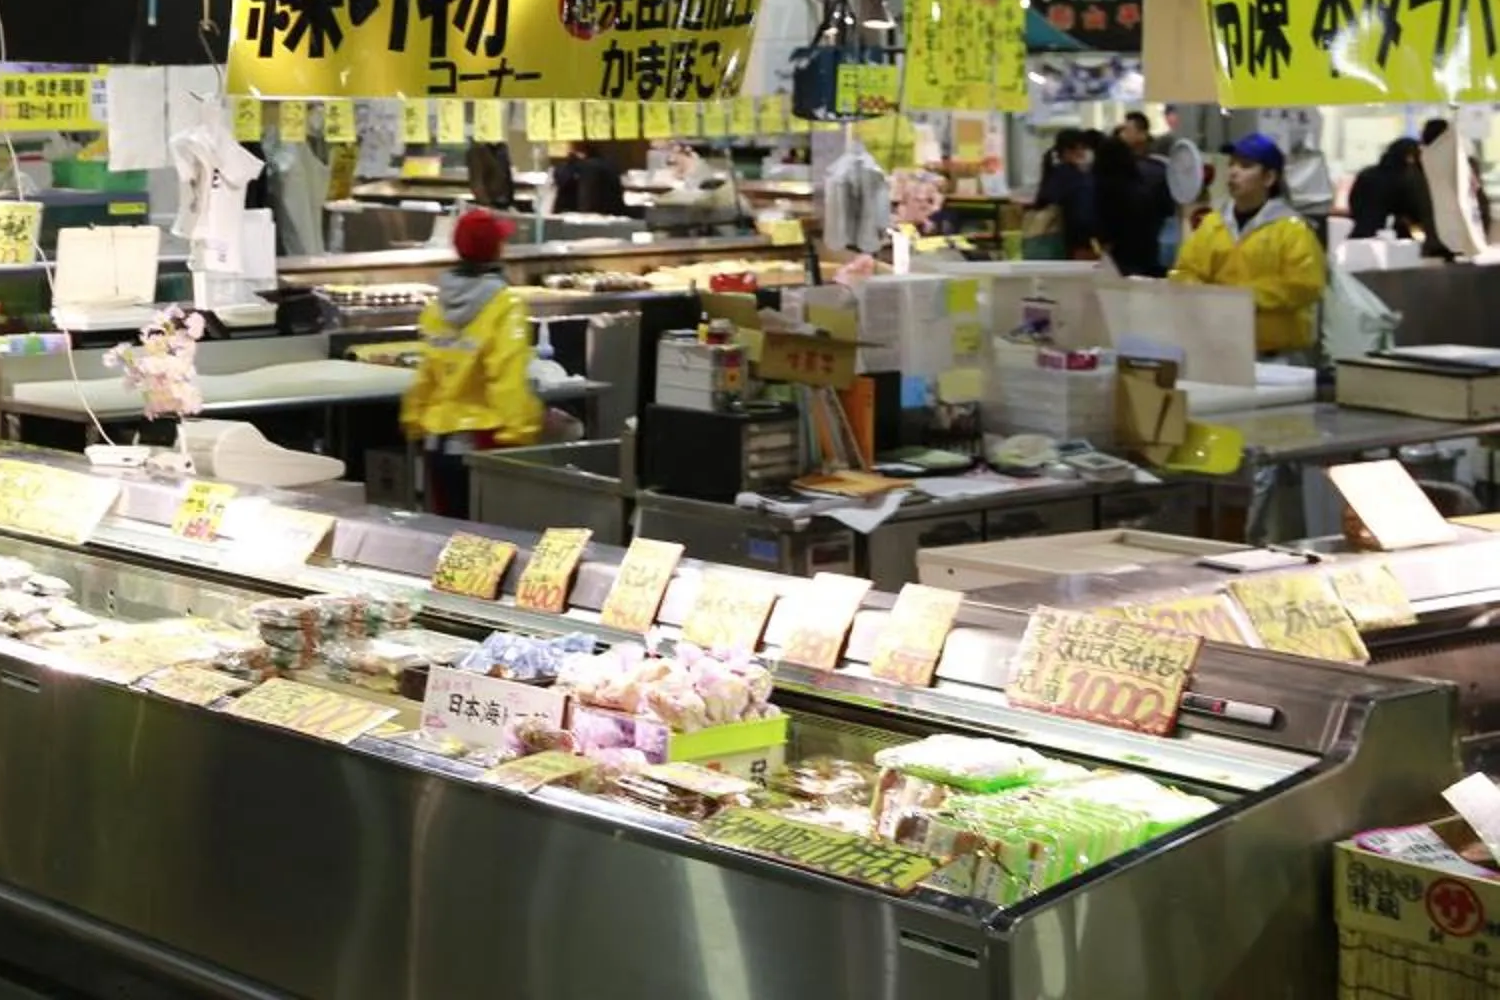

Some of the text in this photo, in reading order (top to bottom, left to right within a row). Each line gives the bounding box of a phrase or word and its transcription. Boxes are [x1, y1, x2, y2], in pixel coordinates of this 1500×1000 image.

[426, 58, 542, 98] コーナー
[600, 38, 742, 100] かまぼこ
